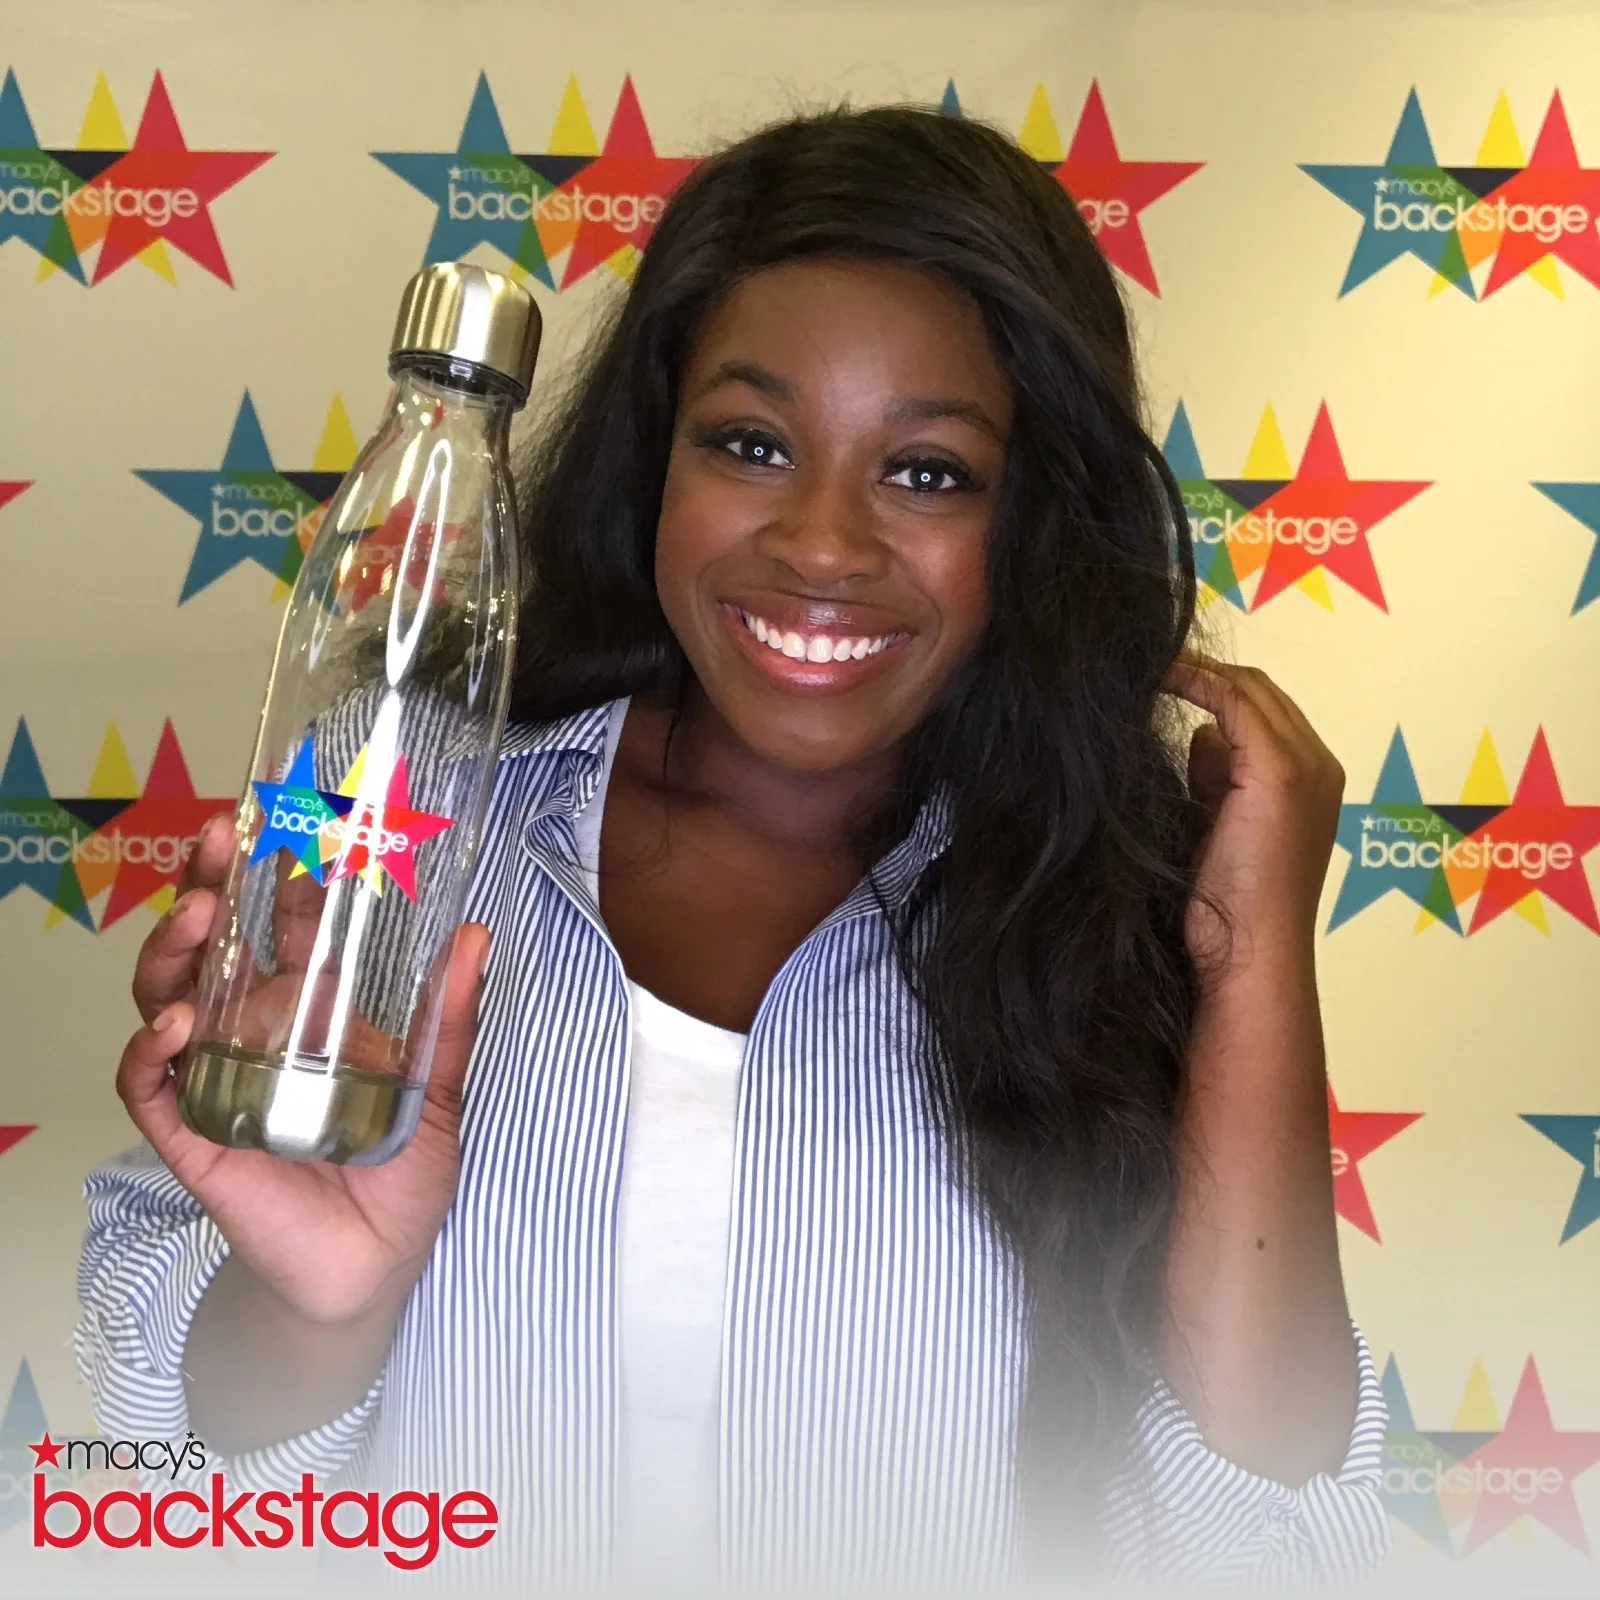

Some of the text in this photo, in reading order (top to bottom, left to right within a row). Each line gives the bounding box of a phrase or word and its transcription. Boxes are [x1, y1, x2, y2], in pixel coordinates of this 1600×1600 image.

[0, 180, 199, 228] ackstage
[447, 183, 665, 233] backstage
[1373, 194, 1589, 243] backstage
[1188, 508, 1358, 555] ckstage
[283, 794, 324, 813] macy's
[1376, 815, 1442, 836] macy's
[269, 804, 409, 856] backsage
[1360, 832, 1574, 880] backstage
[1382, 1459, 1564, 1504] ackstage
